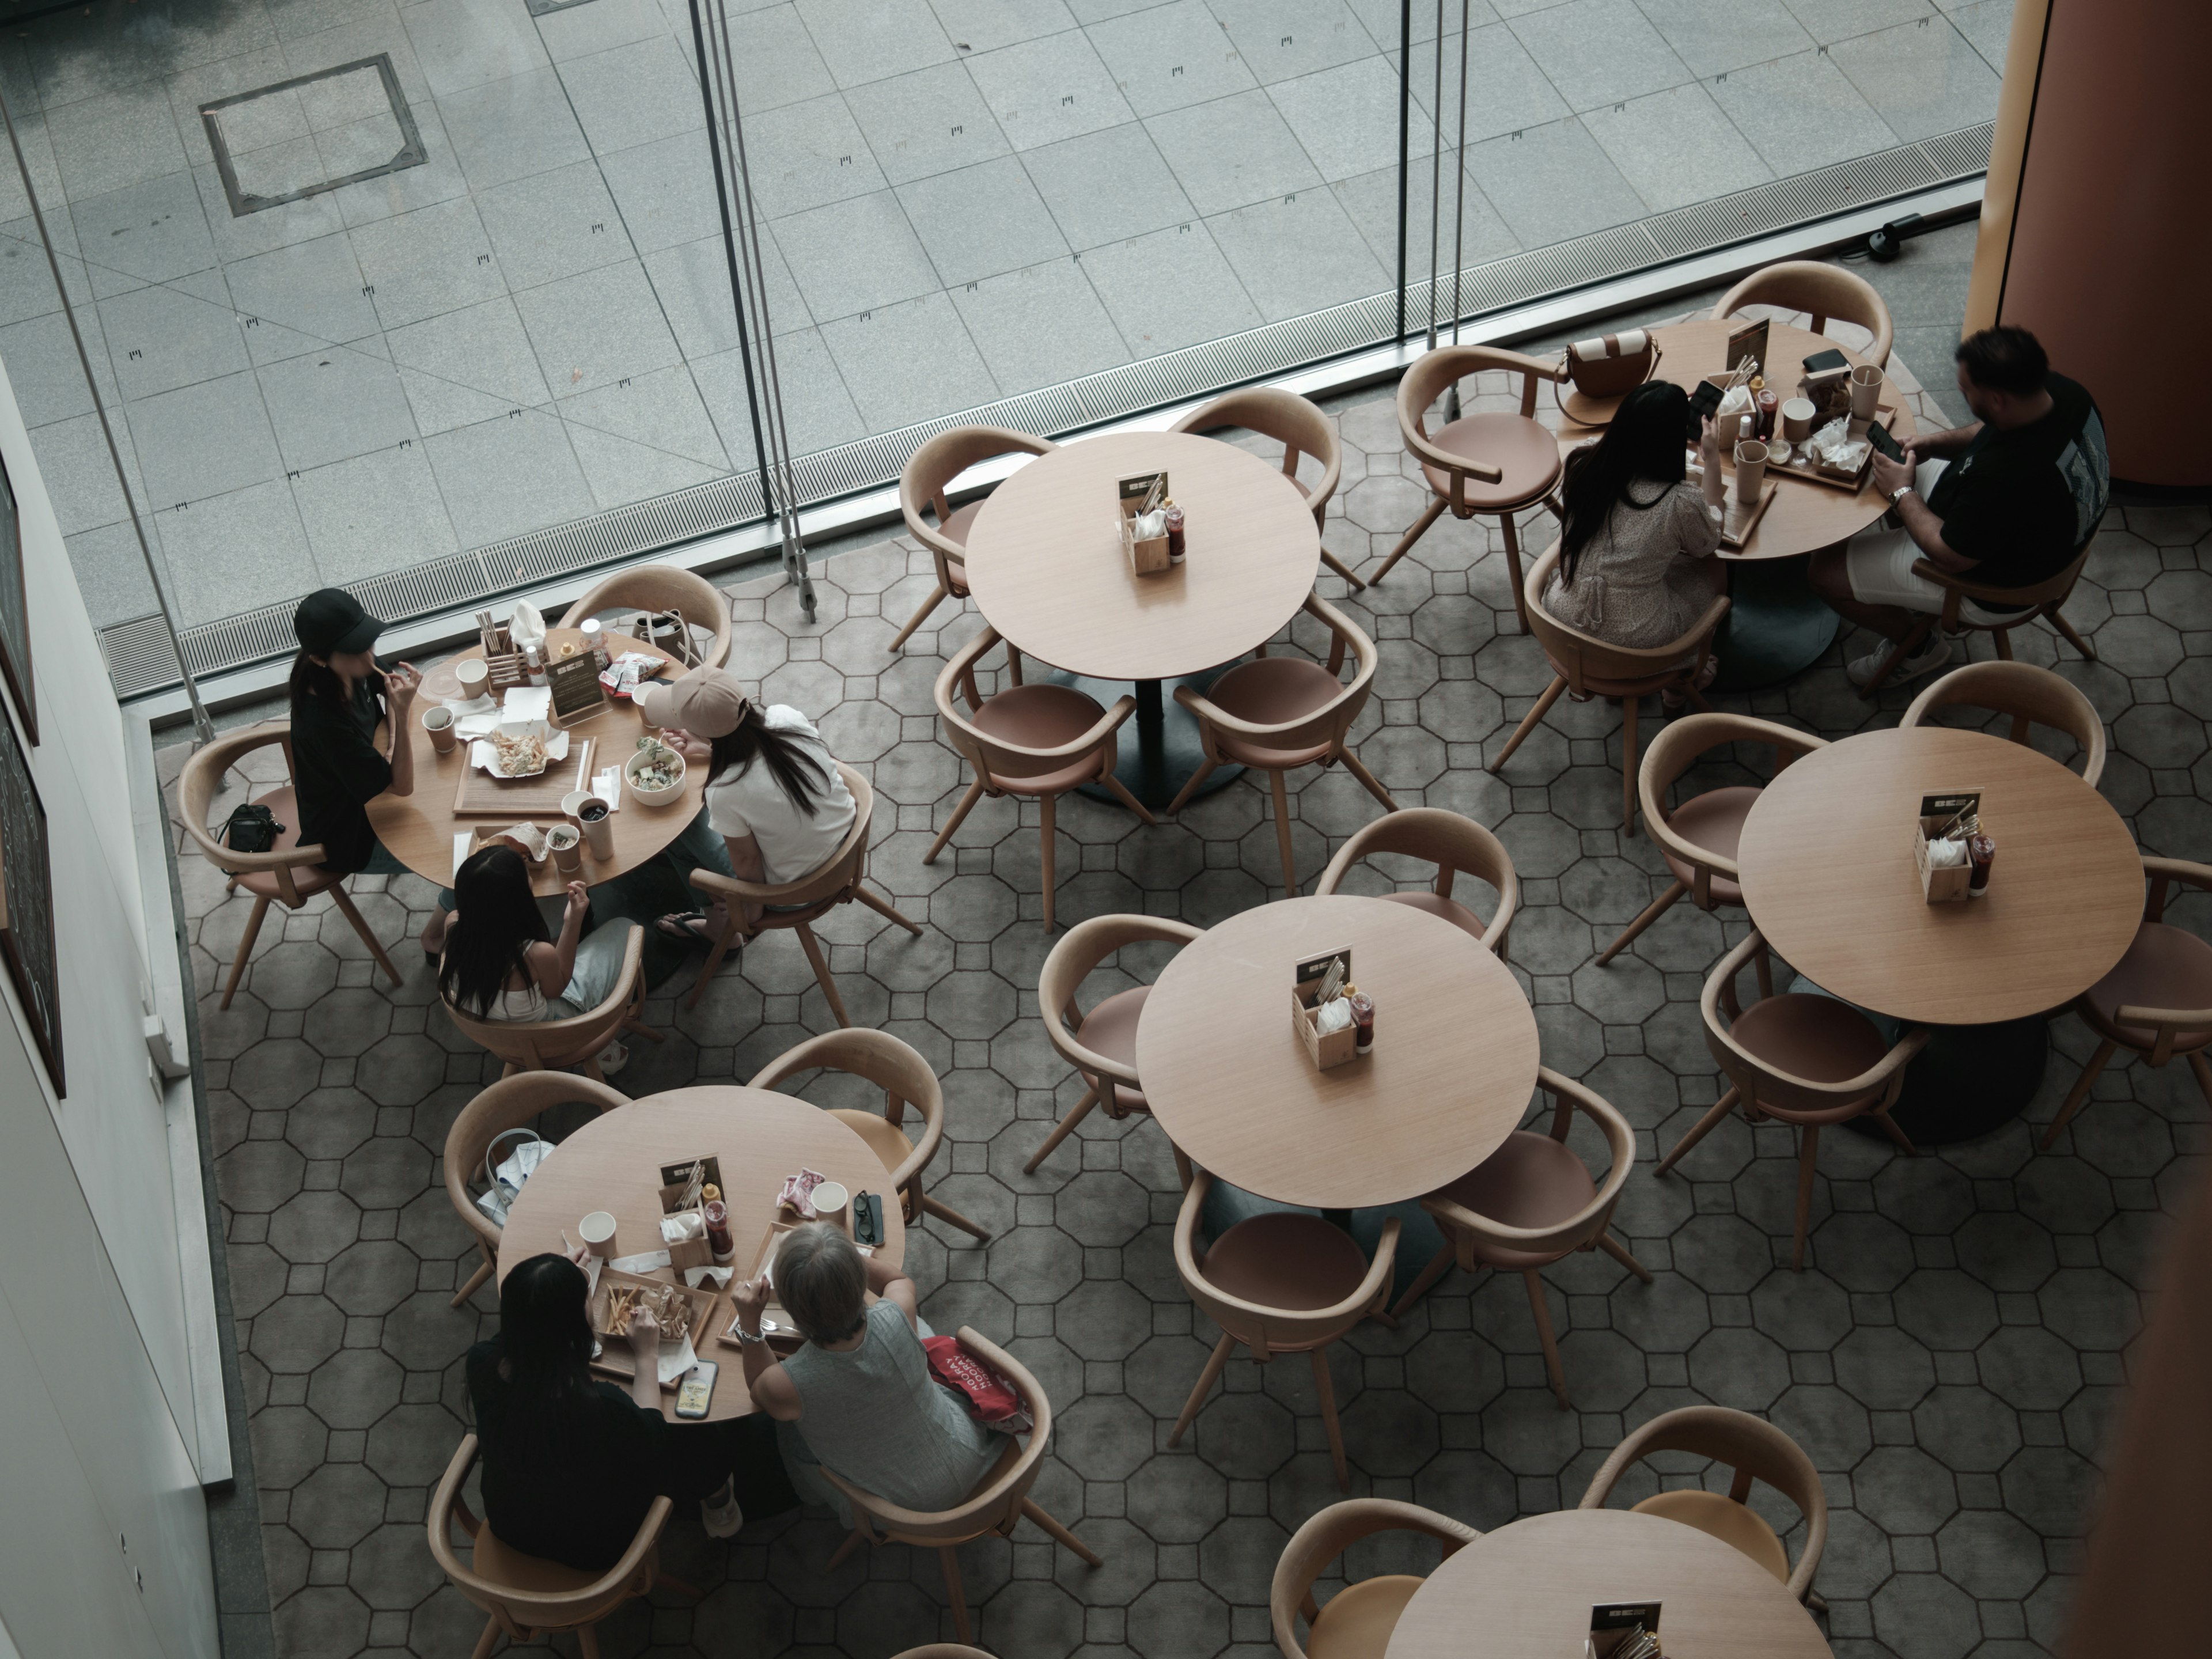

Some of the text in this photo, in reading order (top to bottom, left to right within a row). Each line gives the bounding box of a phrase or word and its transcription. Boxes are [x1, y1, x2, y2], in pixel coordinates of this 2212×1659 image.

[945, 1358, 979, 1390] HOORAY
[953, 1355, 986, 1389] HOORAY
[961, 1354, 993, 1386] HOORAY
